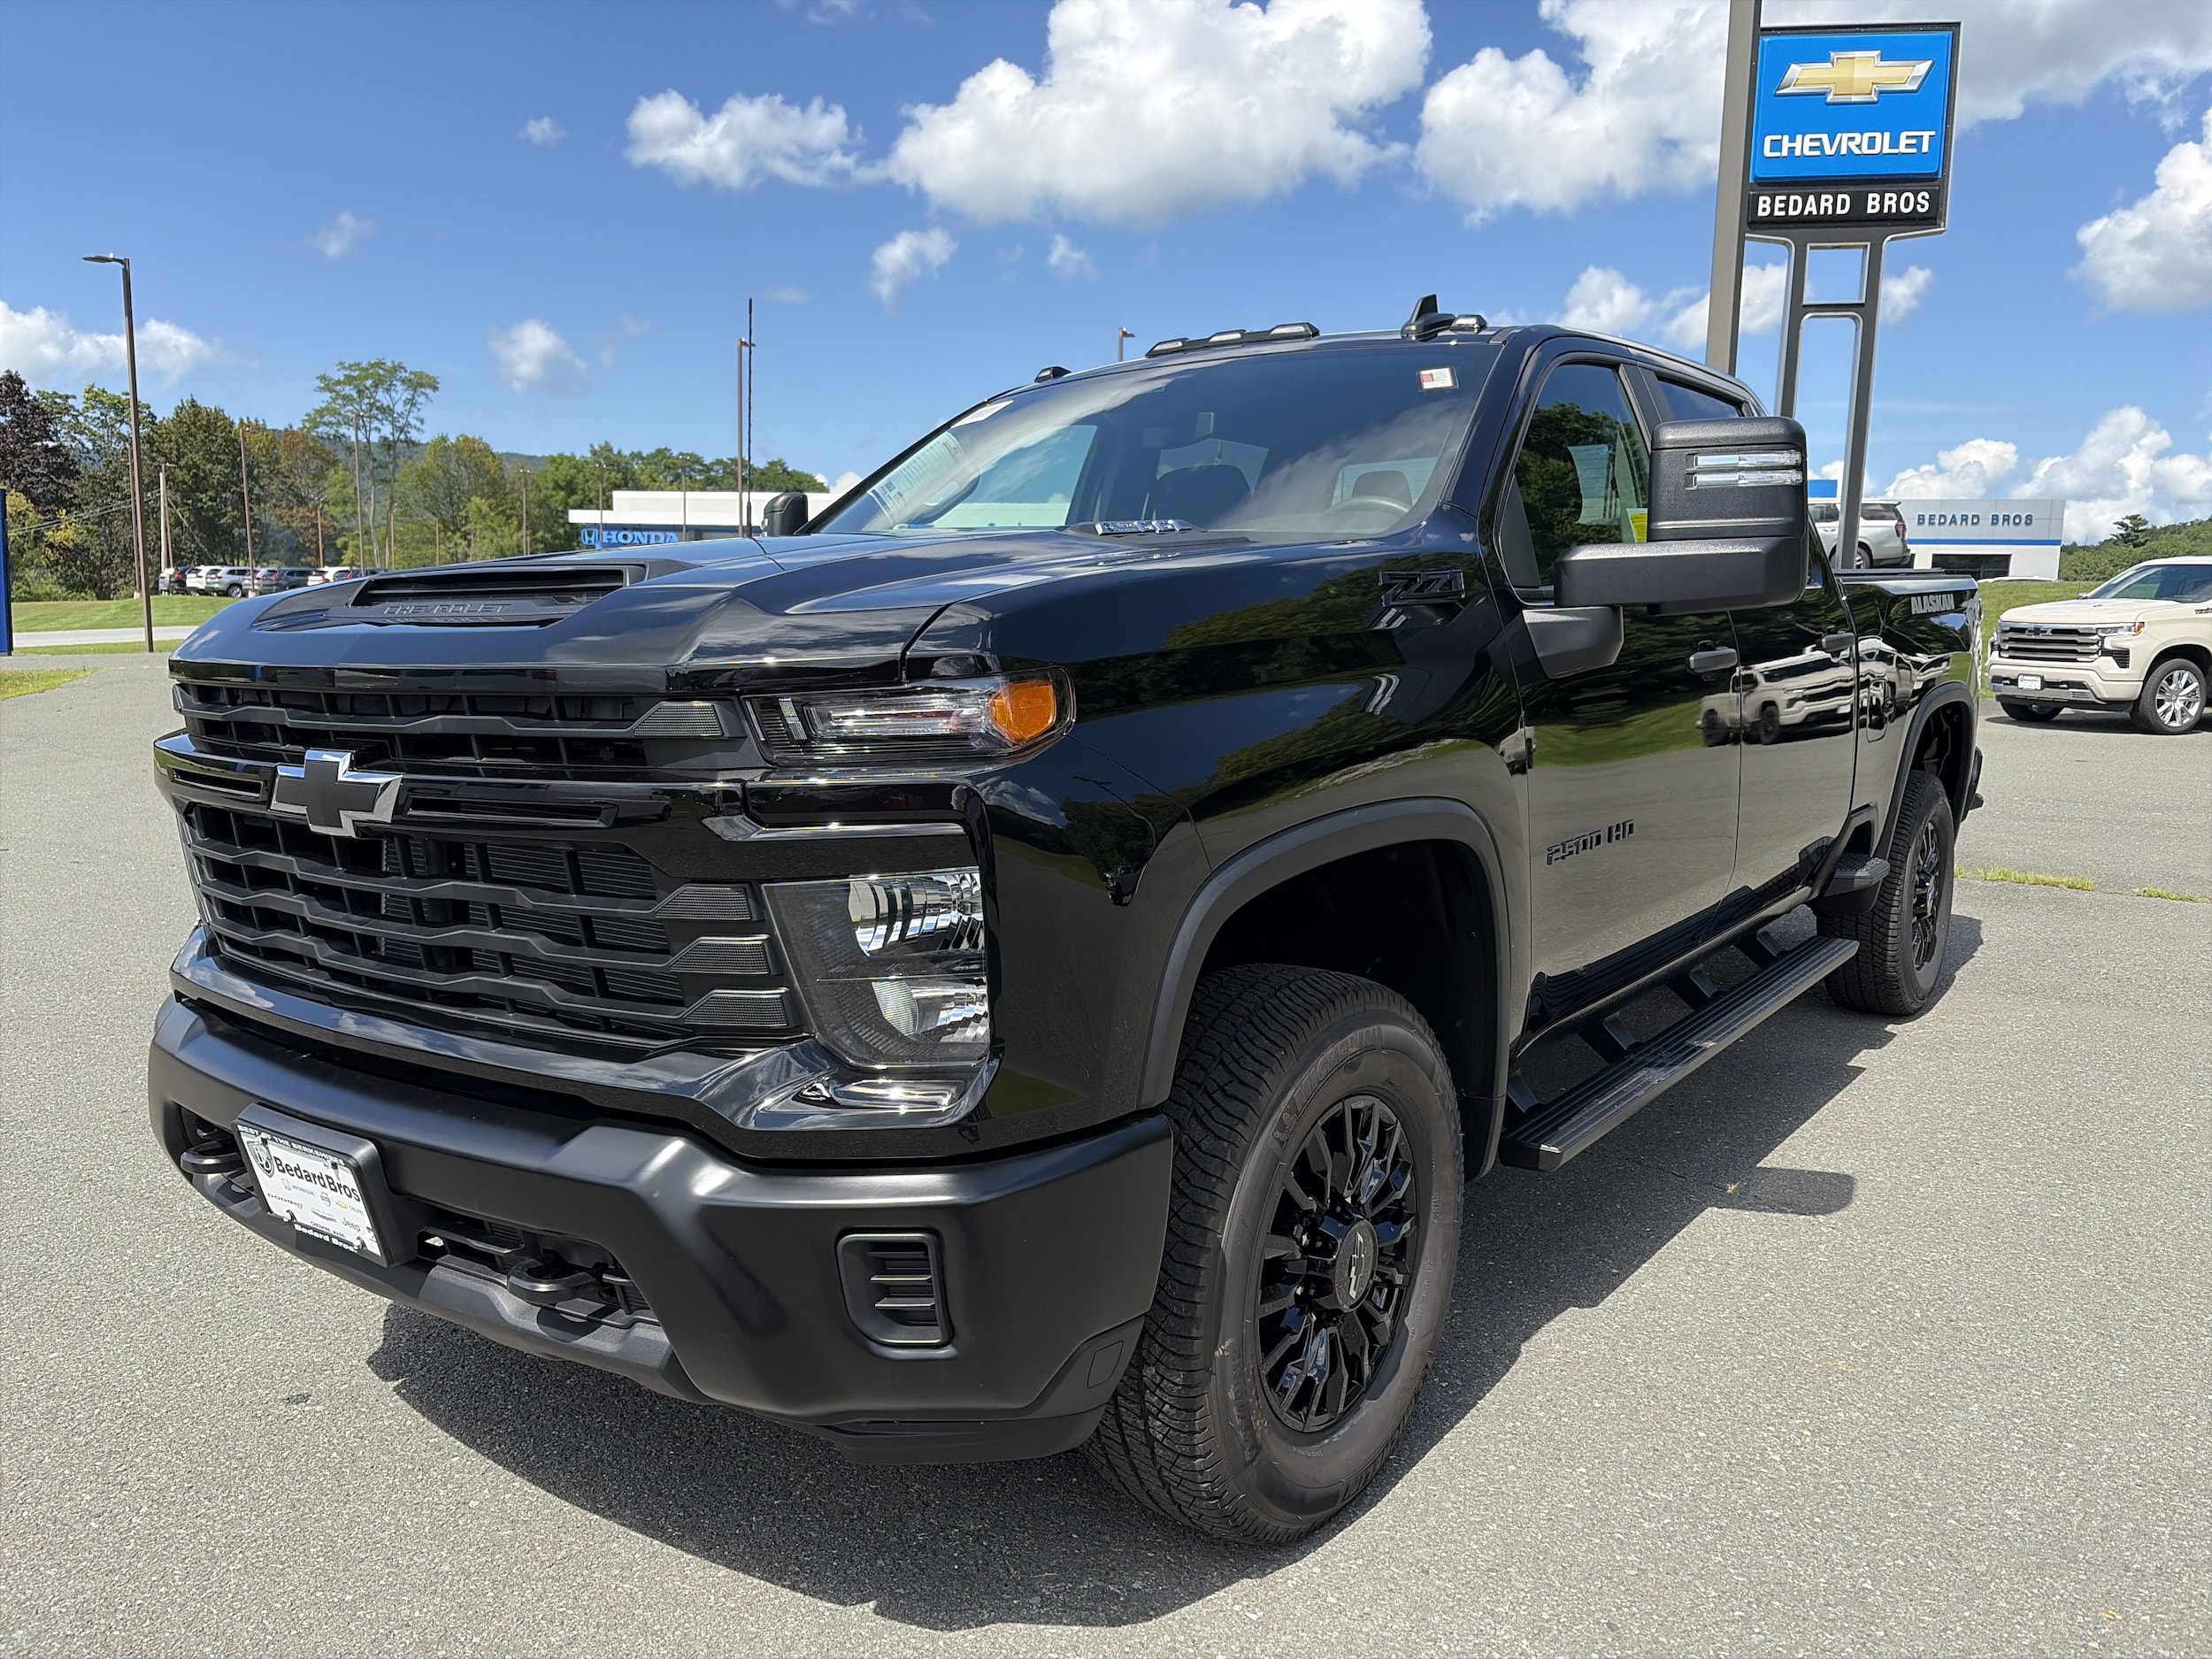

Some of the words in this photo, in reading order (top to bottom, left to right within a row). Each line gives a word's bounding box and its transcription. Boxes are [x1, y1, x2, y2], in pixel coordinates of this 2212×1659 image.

[1763, 131, 1936, 158] CHEVROLET
[1756, 193, 1851, 218] BEDARD
[1865, 190, 1931, 214] BROS
[1916, 513, 1980, 526] BEDARD
[1990, 513, 2033, 526] BROS
[602, 530, 680, 545] HONDA
[383, 603, 512, 615] CHEVROLET
[1910, 593, 1955, 615] ALASKAN
[1546, 828, 1602, 866] 2500
[1607, 818, 1635, 844] HD
[1294, 1024, 1379, 1113] MICHELIN
[237, 1124, 259, 1136] BEST
[273, 1135, 292, 1148] THE
[290, 1141, 346, 1166] BERKSHIRES
[294, 1223, 331, 1242] Bedard
